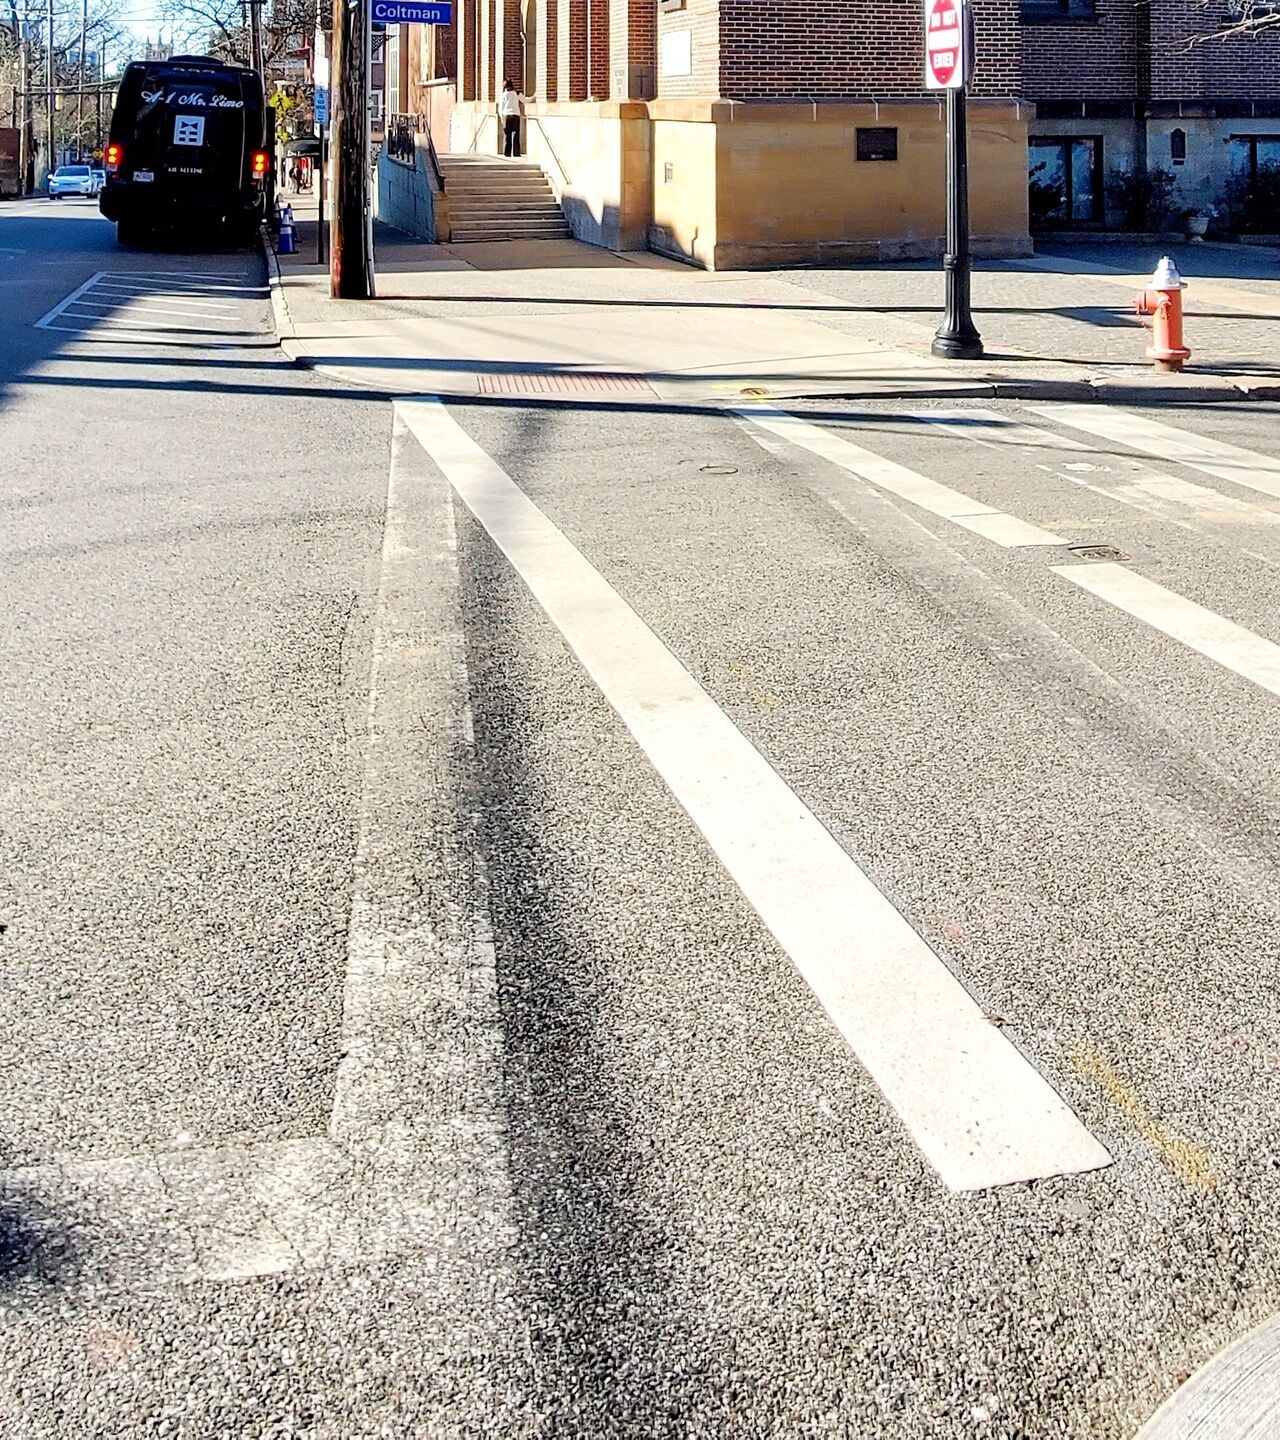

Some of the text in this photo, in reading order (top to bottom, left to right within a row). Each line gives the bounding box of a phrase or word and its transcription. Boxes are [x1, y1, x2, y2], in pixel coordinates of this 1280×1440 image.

[375, 4, 441, 20] Coltman
[931, 9, 957, 28] DO NOT
[933, 52, 955, 68] ENTER
[209, 94, 244, 108] Limo
